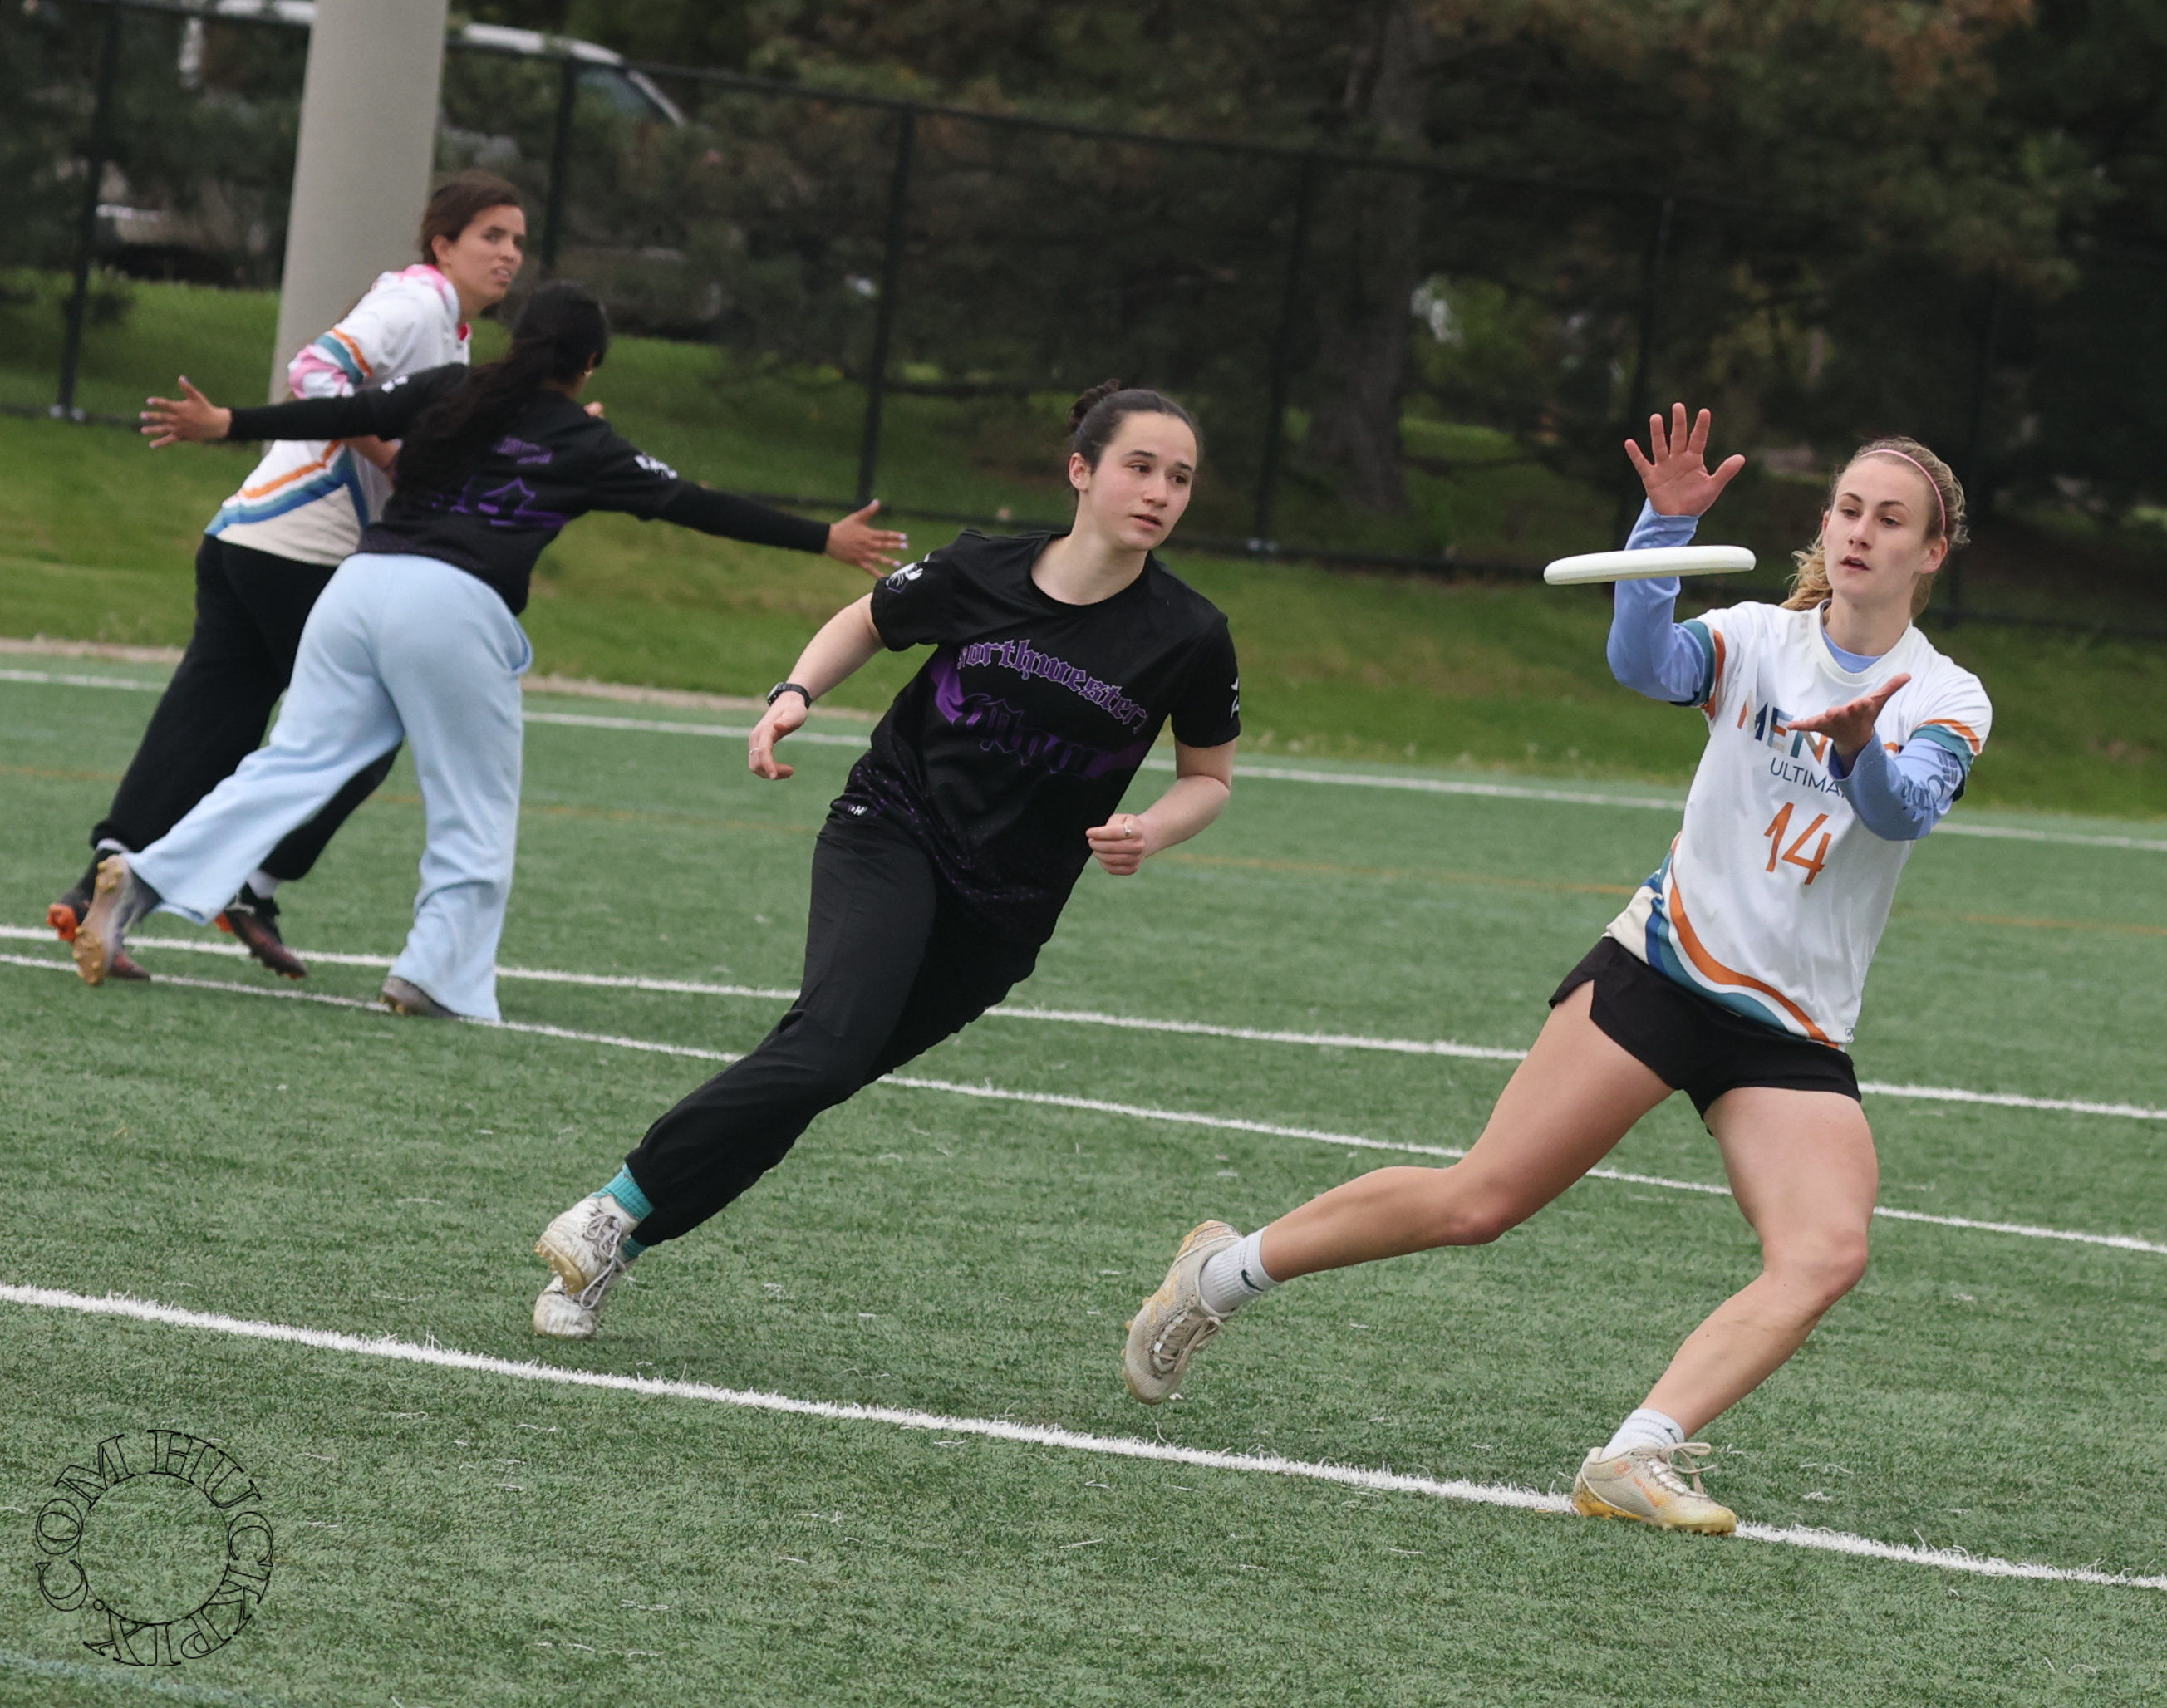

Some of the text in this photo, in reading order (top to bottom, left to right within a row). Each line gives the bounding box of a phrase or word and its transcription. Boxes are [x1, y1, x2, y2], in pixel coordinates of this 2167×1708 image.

[957, 639, 1148, 734] orthwester
[1737, 690, 1832, 766] MEN
[1770, 757, 1845, 798] ULTIMA
[1764, 802, 1832, 886] 14
